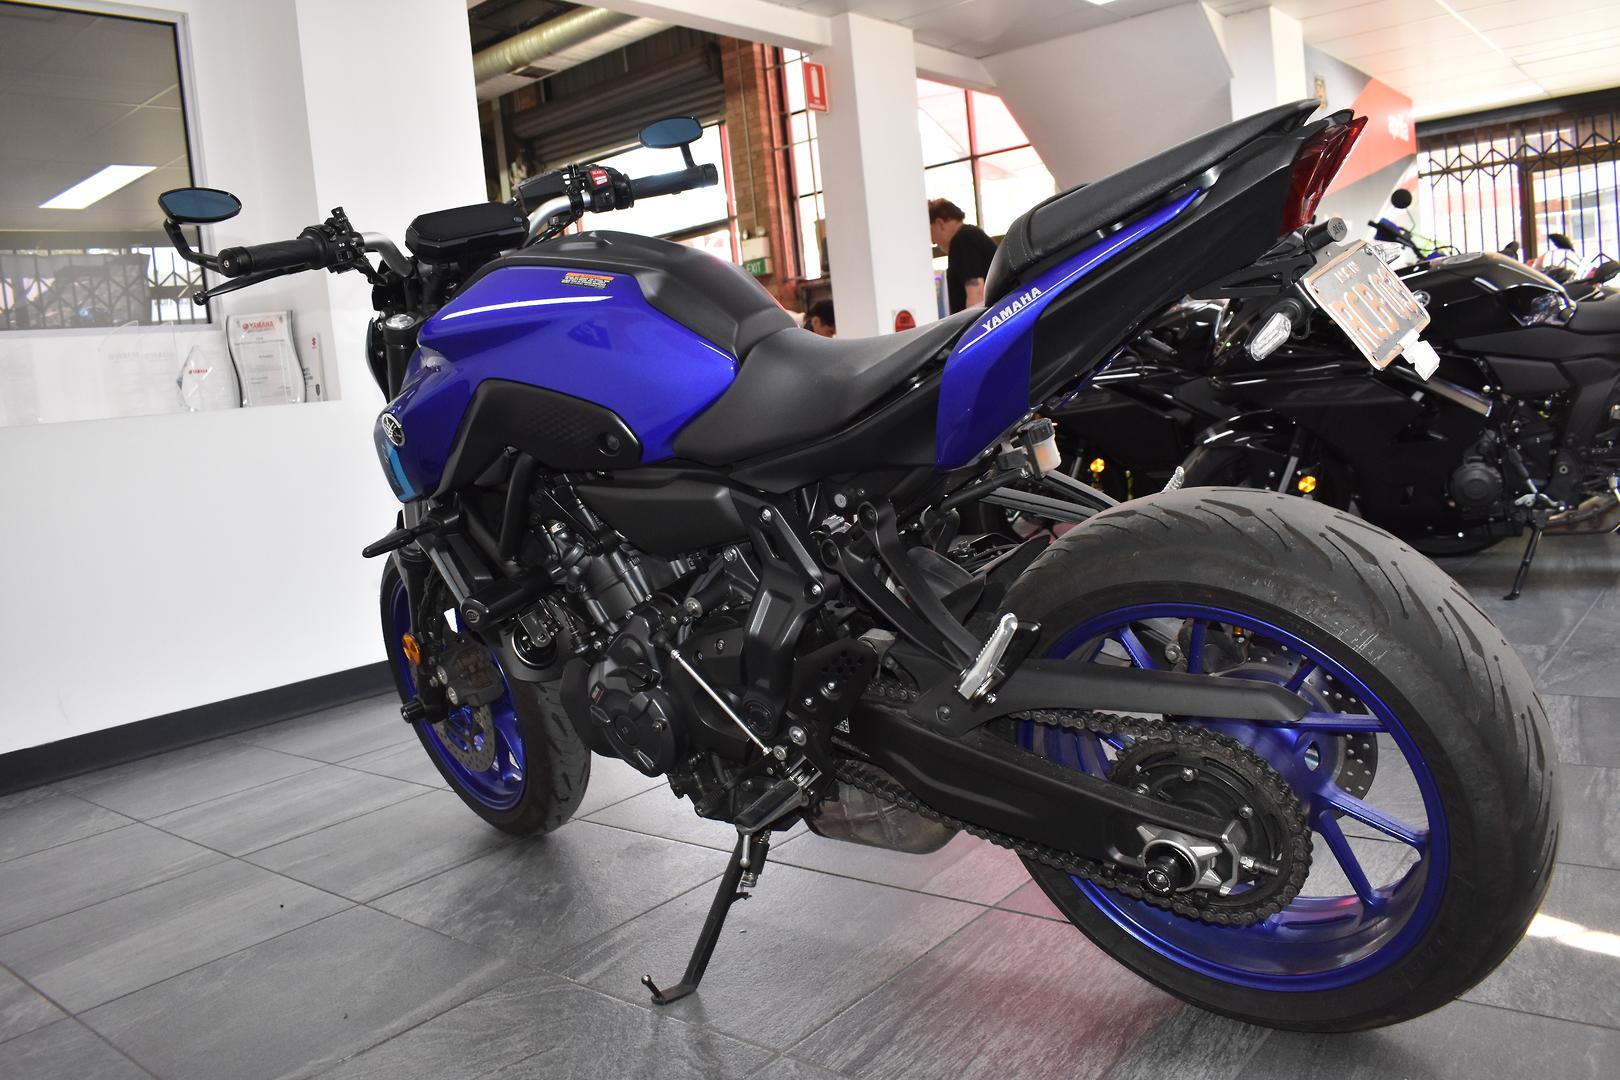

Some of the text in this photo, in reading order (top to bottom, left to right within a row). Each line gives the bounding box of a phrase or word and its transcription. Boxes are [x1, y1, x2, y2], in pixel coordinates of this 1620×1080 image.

[745, 259, 761, 272] EXIT
[982, 287, 1042, 331] YAMAHA
[249, 320, 273, 329] YAMAHA
